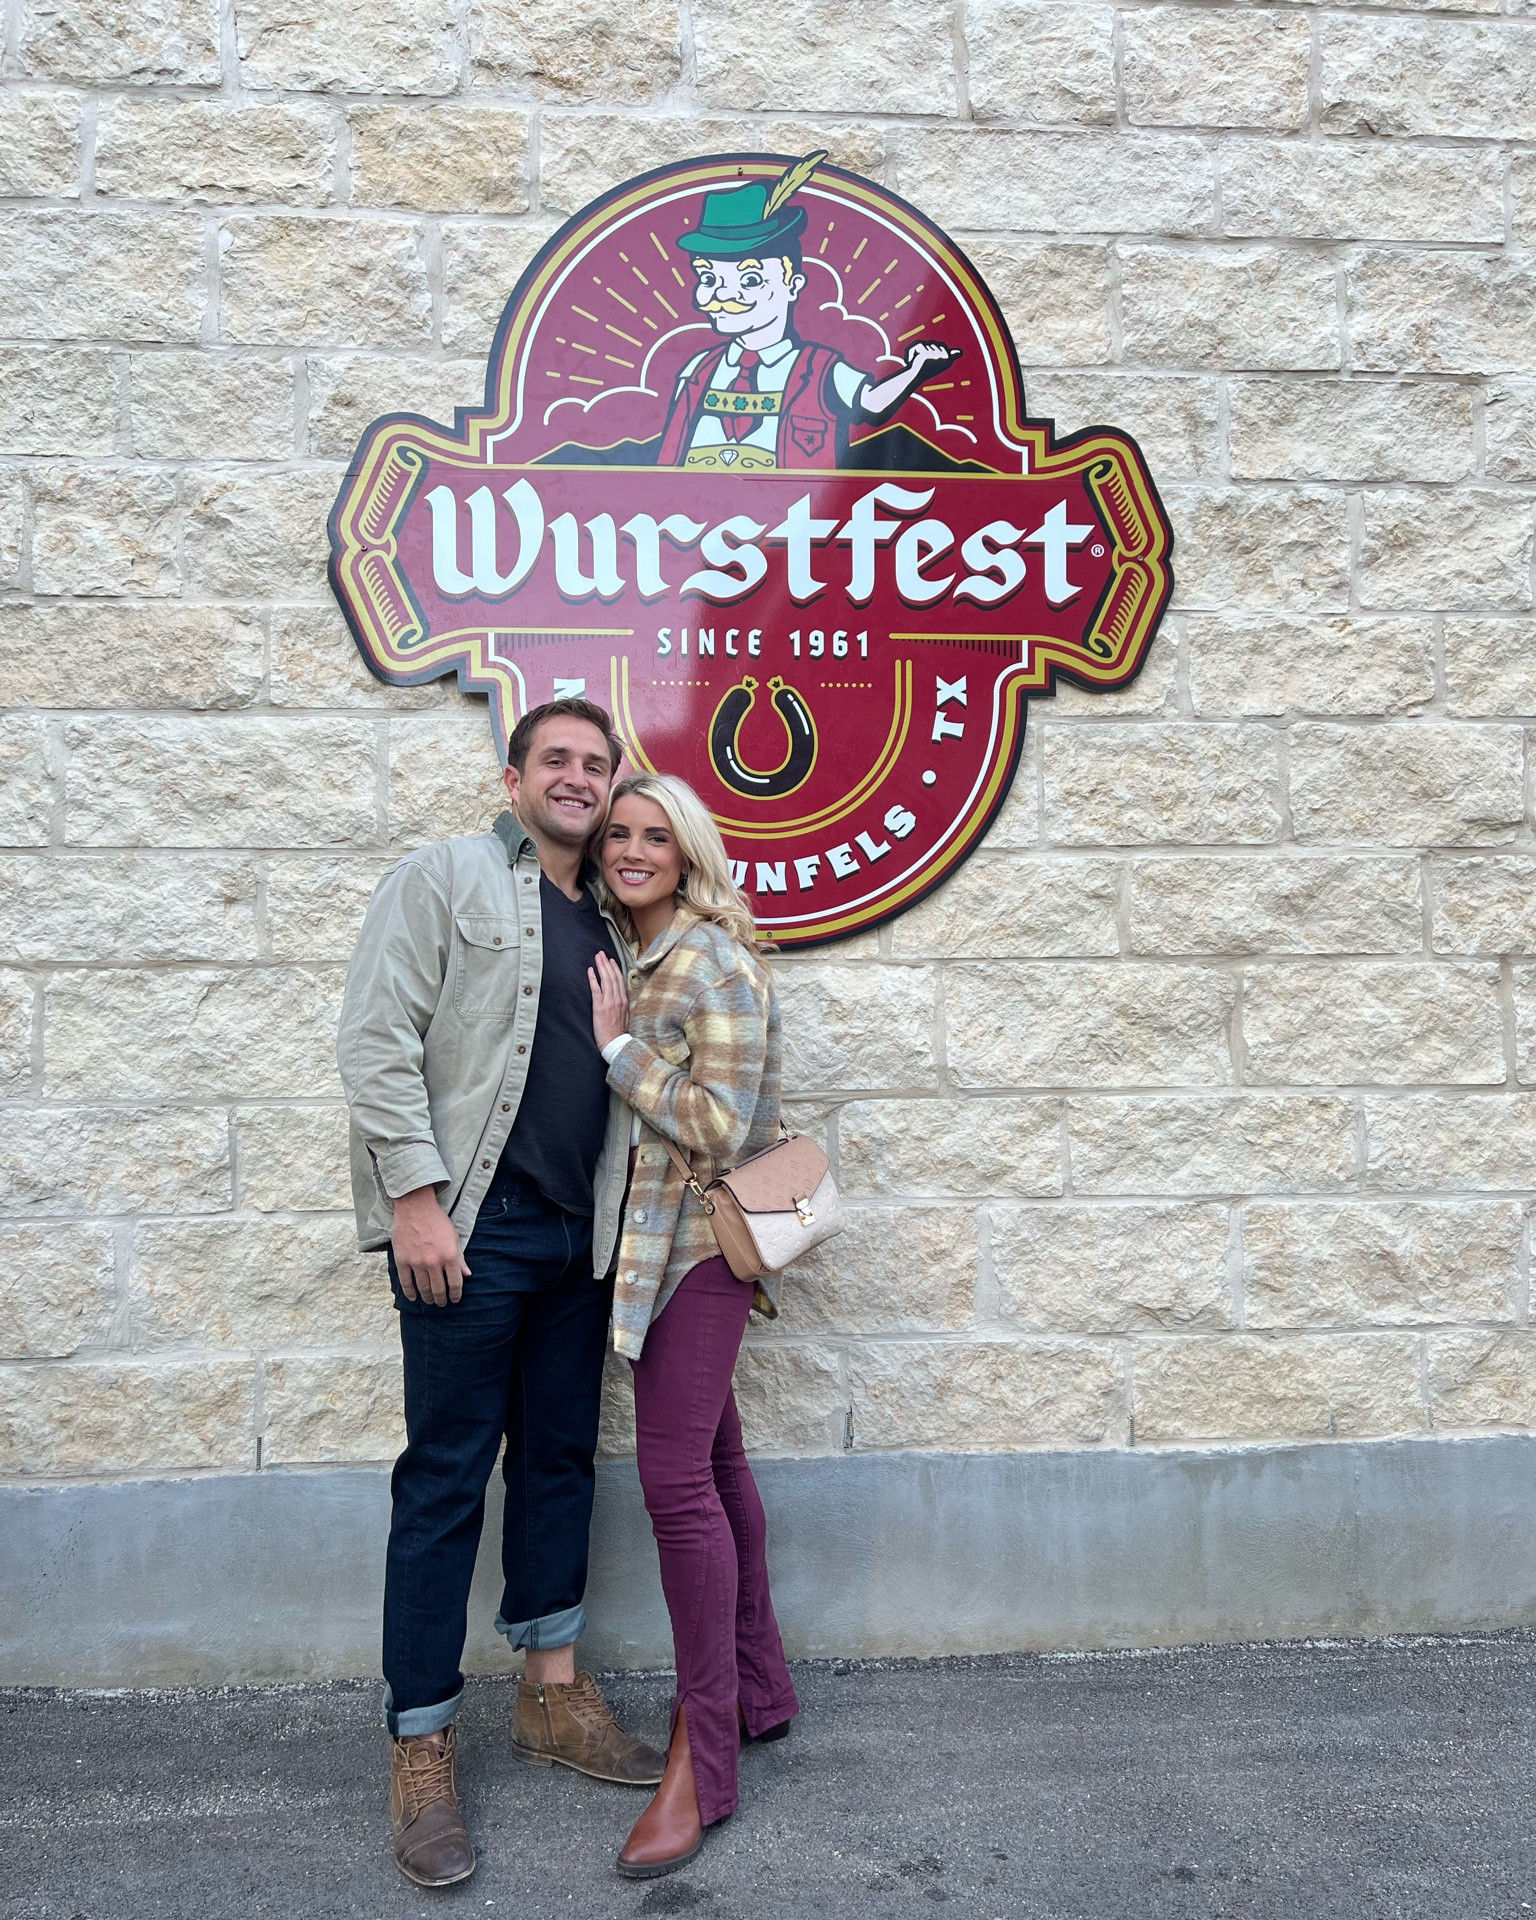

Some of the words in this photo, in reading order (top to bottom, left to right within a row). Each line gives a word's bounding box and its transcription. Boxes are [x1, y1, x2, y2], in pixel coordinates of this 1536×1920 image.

[656, 627, 764, 657] SINCE
[789, 629, 868, 657] 1961
[727, 804, 916, 892] UNFELS
[932, 675, 968, 743] TX
